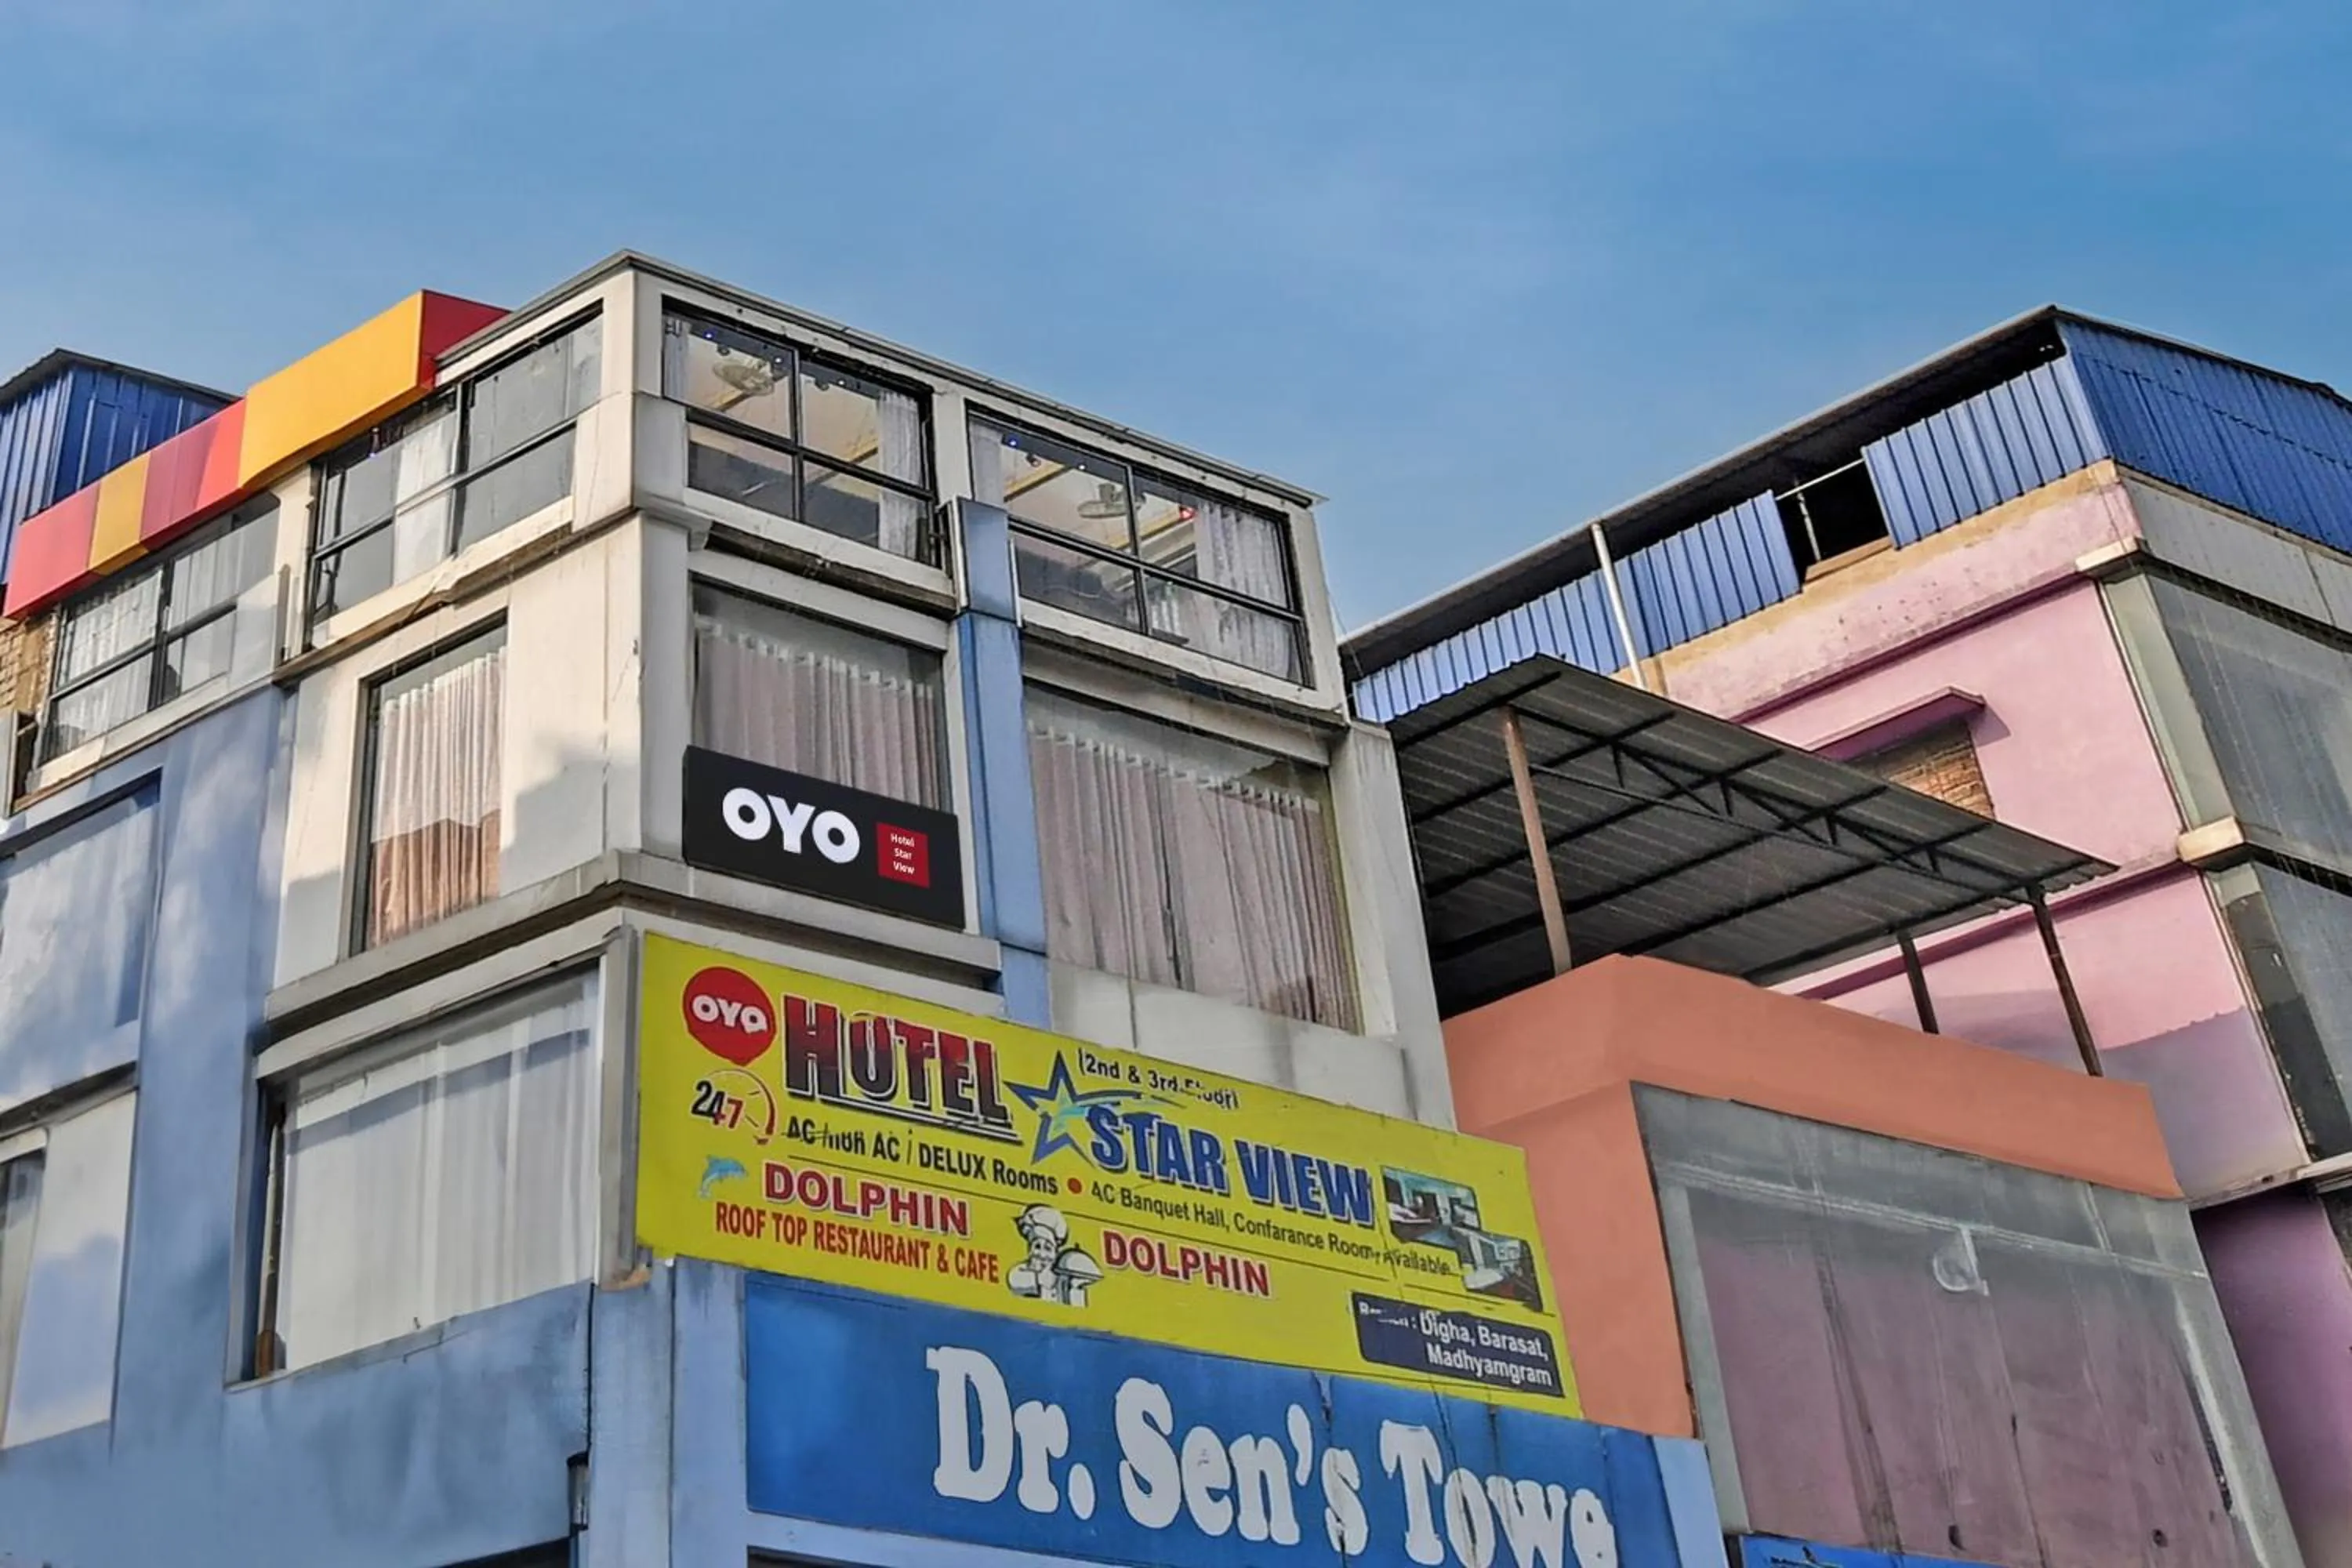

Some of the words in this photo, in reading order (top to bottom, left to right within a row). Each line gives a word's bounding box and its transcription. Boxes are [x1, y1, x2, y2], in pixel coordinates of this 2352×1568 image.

[722, 787, 860, 863] OYO
[890, 833, 915, 847] Hotel
[893, 861, 915, 875] View
[894, 848, 913, 860] Star
[691, 994, 768, 1033] OYO
[1127, 1066, 1140, 1084] &
[918, 1142, 988, 1182] DELUX
[993, 1160, 1059, 1197] Rooms
[1085, 1103, 1231, 1198] STAR
[1234, 1139, 1377, 1230] VIEW
[764, 1161, 971, 1238] DOLPHIN
[1091, 1181, 1116, 1204] AC
[1120, 1187, 1191, 1221] Banquet
[1193, 1202, 1231, 1232] Hall,
[715, 1202, 767, 1240] ROOF
[771, 1213, 808, 1247] TOP
[813, 1220, 931, 1271] RESTAURANT
[936, 1242, 949, 1273] &
[954, 1247, 1000, 1283] CAFE
[1102, 1230, 1271, 1298] DOLPHIN
[1425, 1341, 1552, 1387] Madhyamgram
[1478, 1326, 1549, 1361] Barasat,
[926, 1346, 1096, 1520] Dr.
[1115, 1377, 1370, 1555] Sen's
